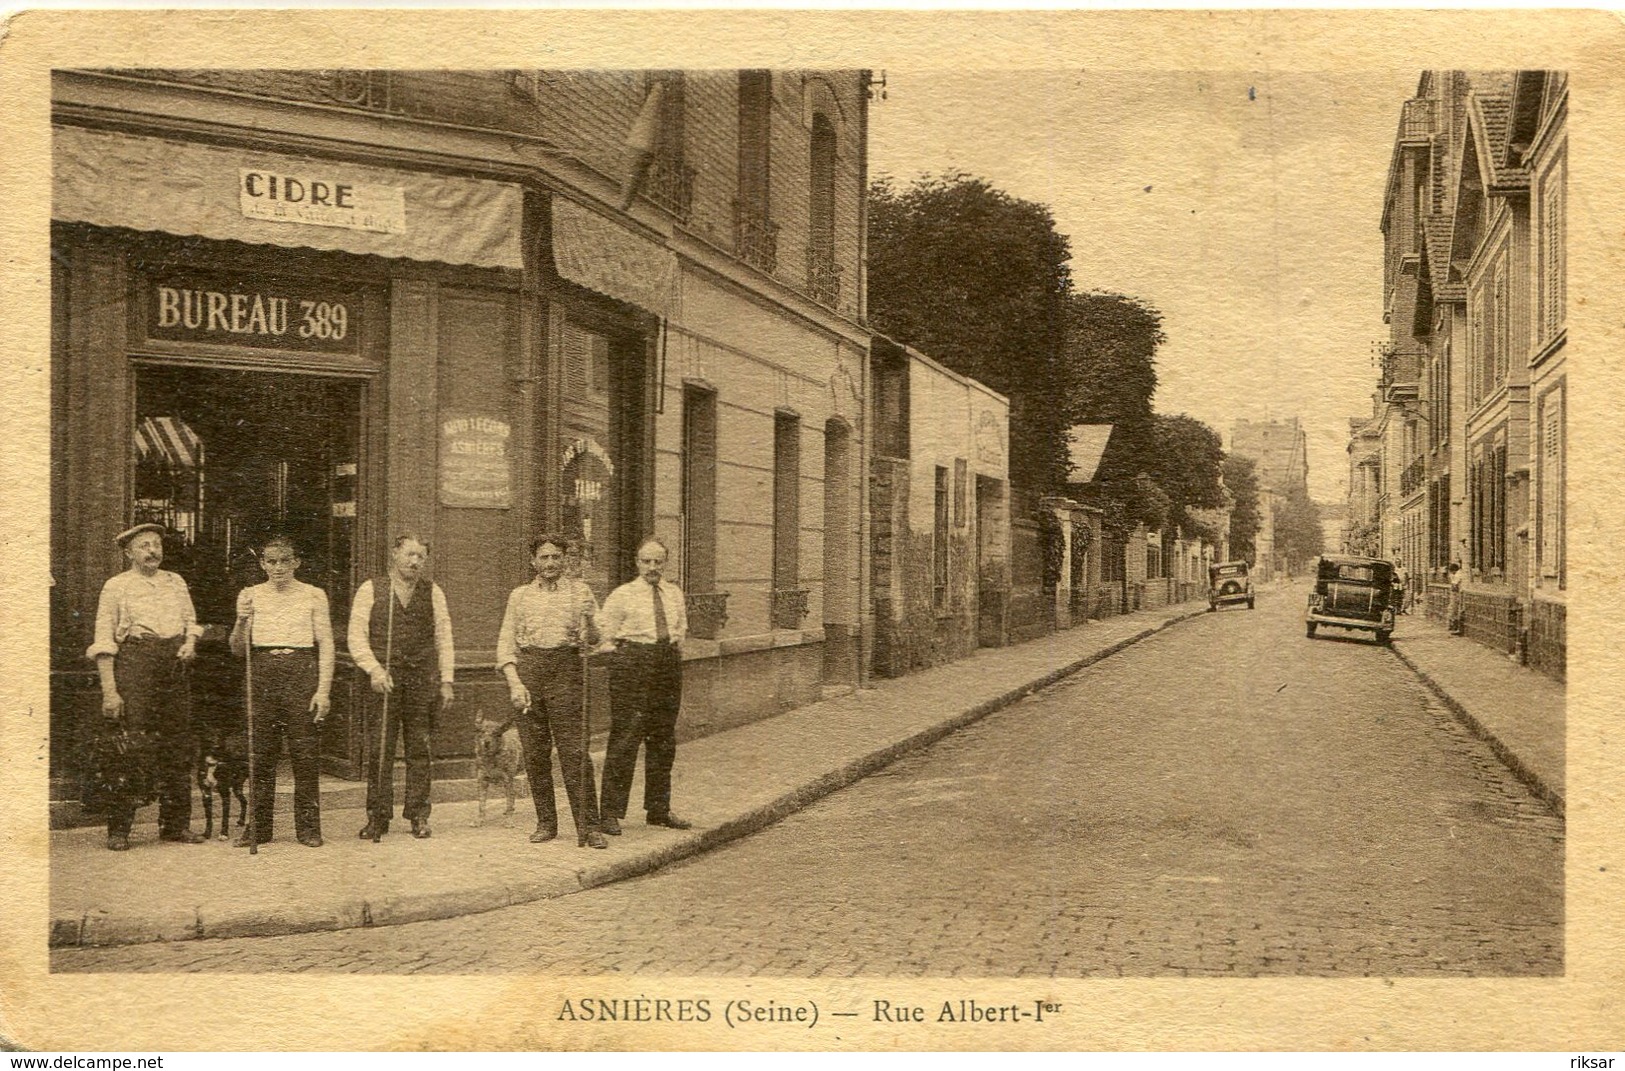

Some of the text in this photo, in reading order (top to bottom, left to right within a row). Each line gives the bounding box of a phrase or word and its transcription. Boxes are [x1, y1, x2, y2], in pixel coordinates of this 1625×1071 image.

[245, 172, 354, 209] CIDRE
[157, 286, 348, 340] BUREAU 389
